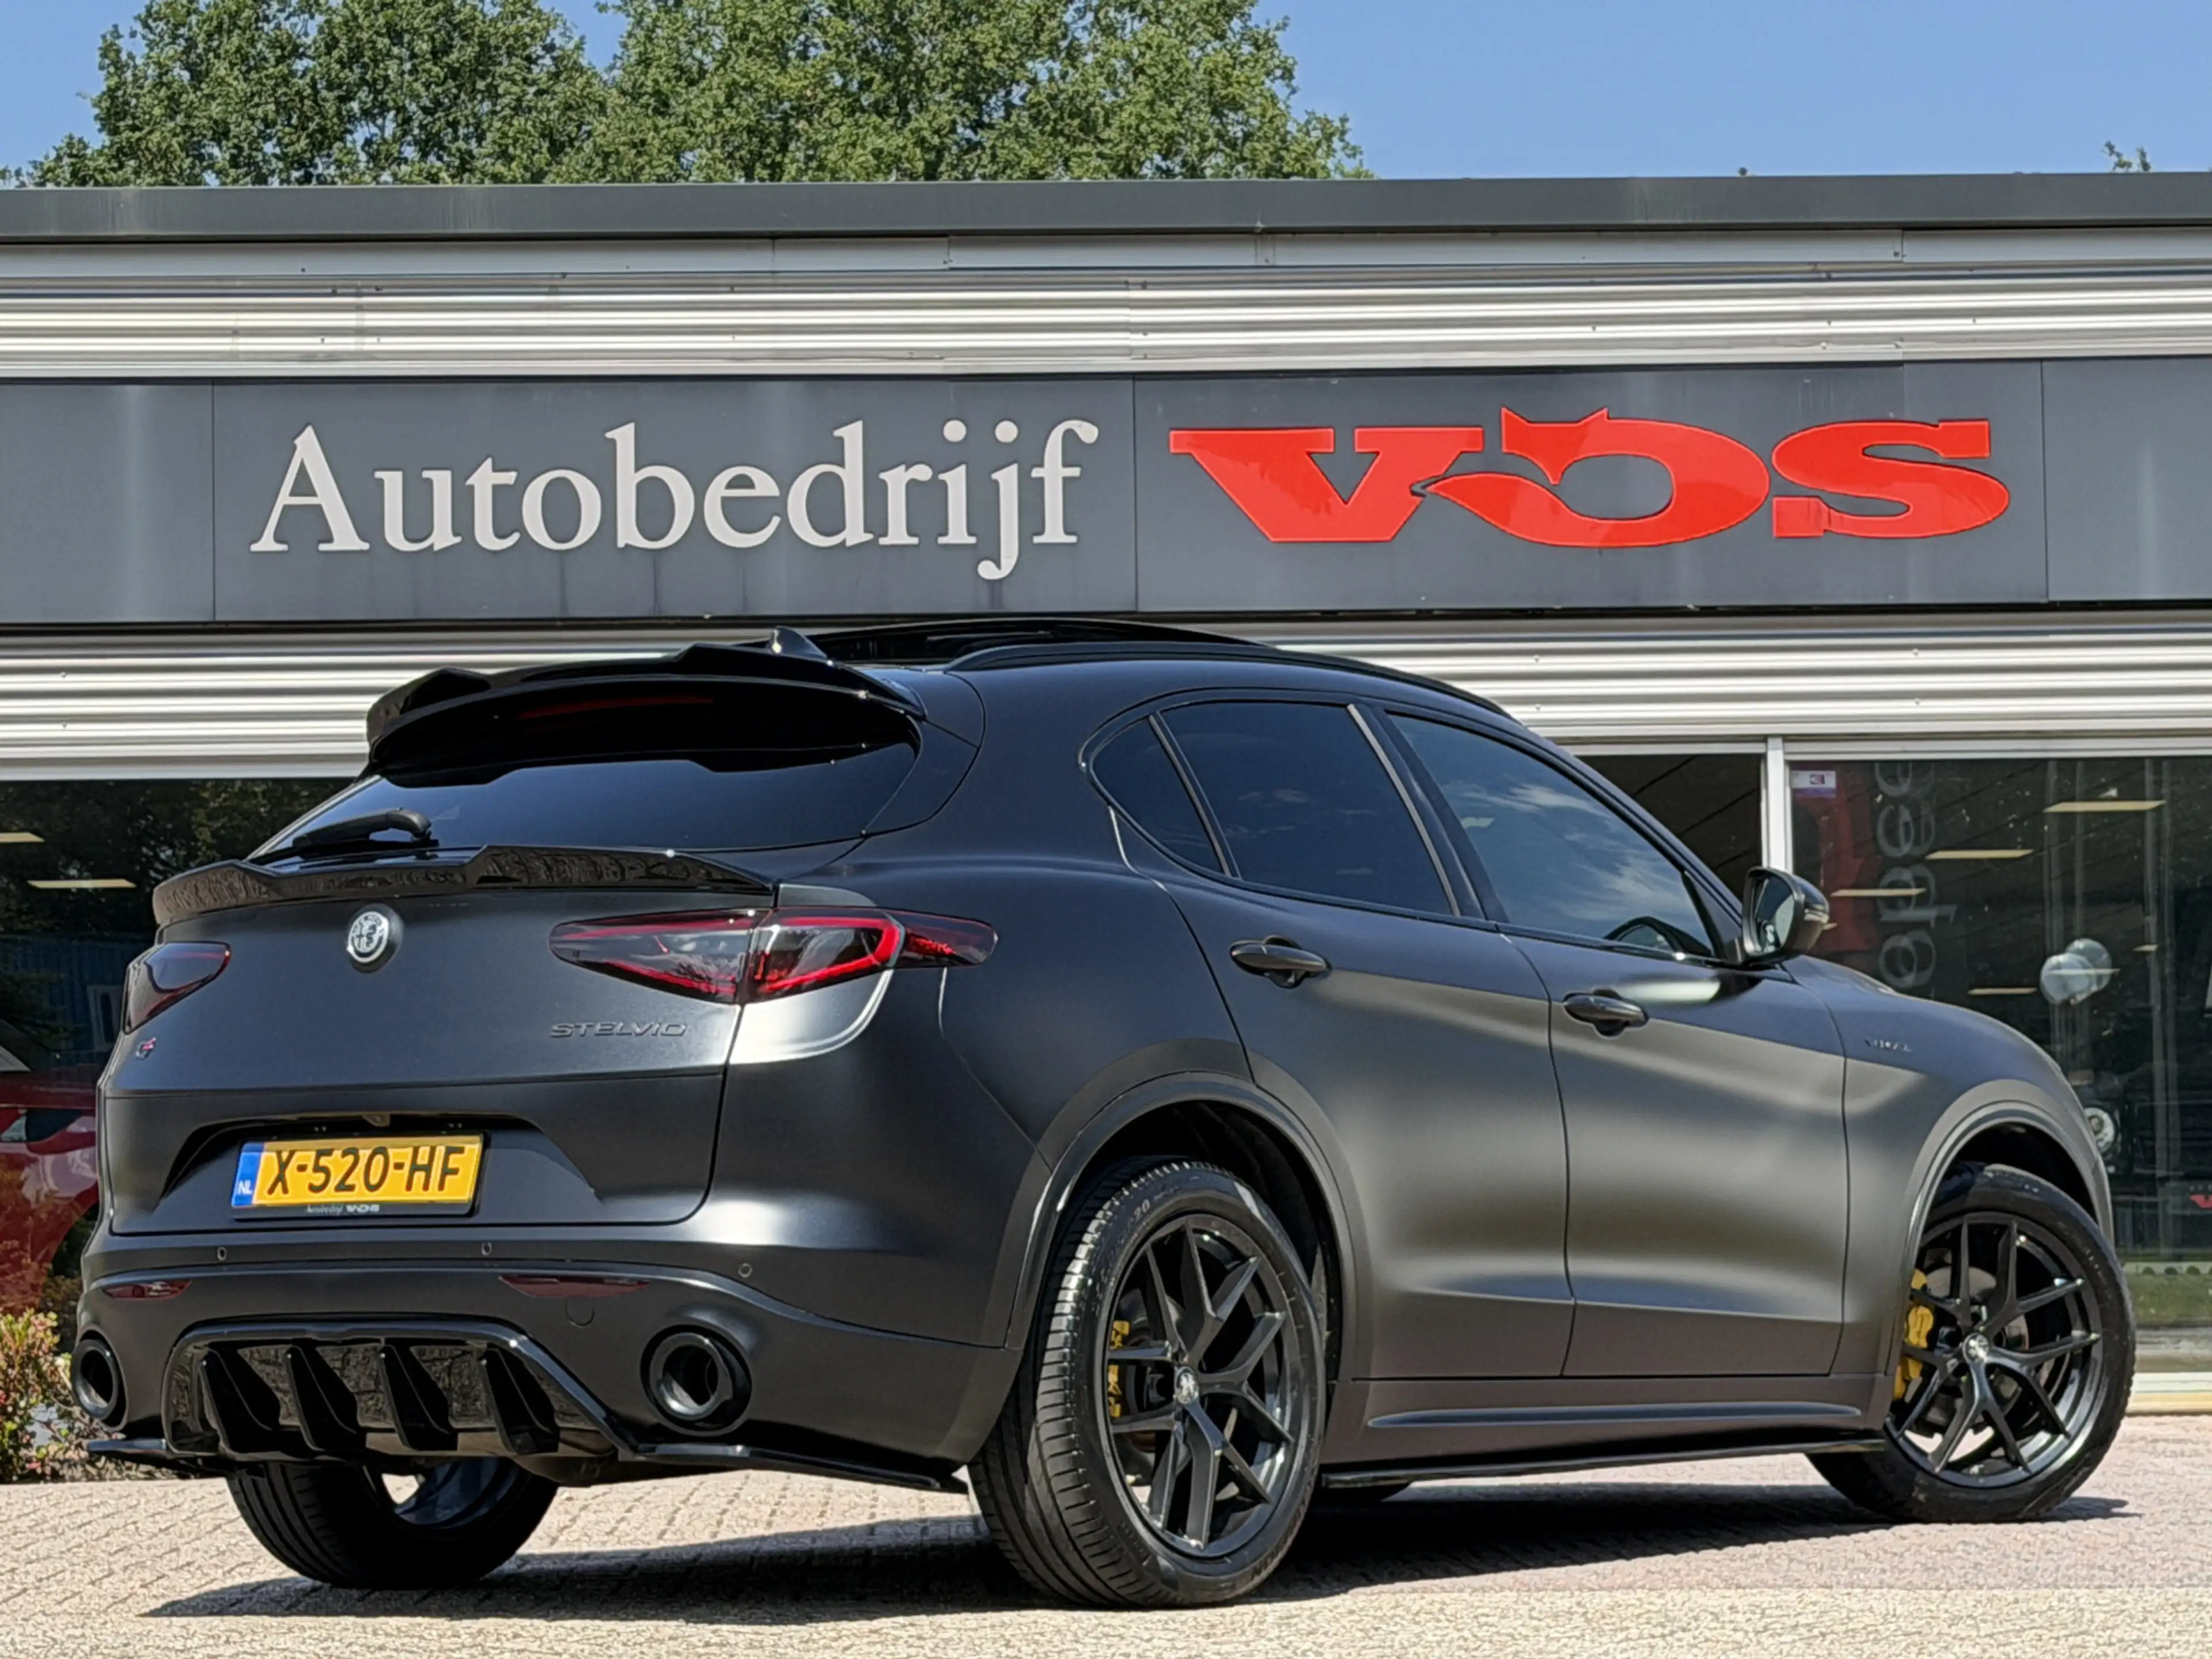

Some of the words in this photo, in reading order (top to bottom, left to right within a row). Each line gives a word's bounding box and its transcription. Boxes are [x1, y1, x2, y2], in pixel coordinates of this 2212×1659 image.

[250, 420, 1099, 579] Autobedrijf
[1169, 408, 2010, 548] VOS
[551, 1021, 688, 1038] STELVIO
[237, 1180, 252, 1195] NL
[267, 1145, 465, 1195] X-520-HF
